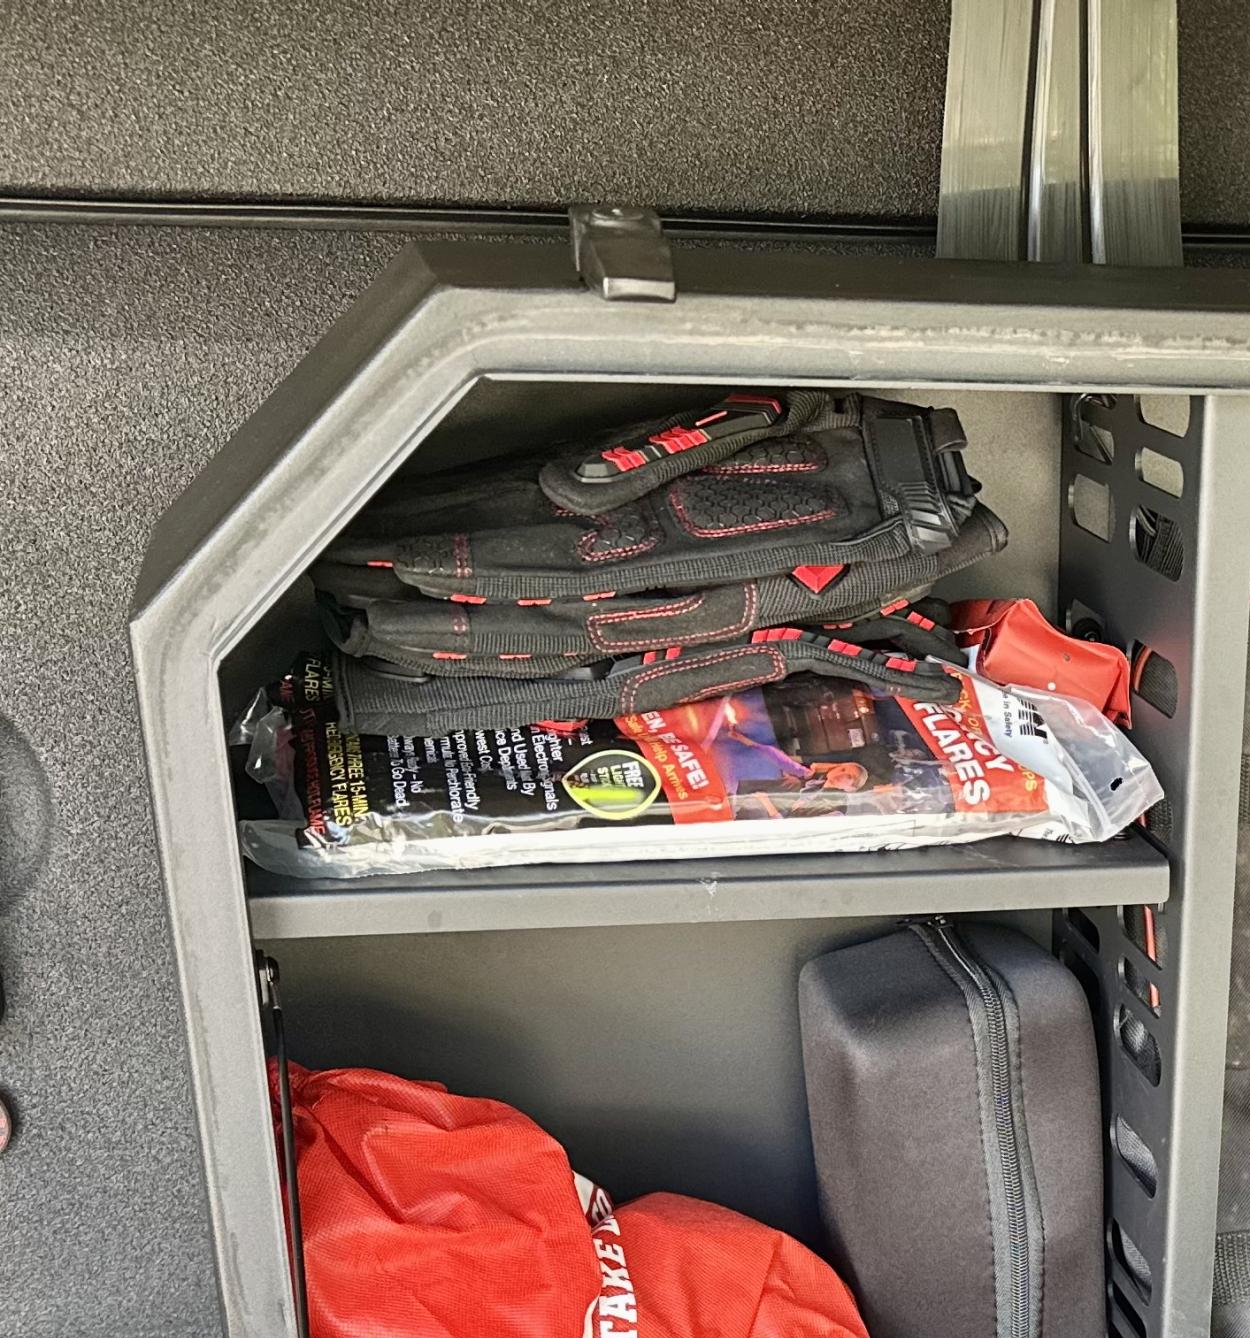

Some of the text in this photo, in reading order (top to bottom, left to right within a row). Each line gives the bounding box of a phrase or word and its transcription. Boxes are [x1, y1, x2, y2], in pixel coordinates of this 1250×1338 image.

[304, 657, 321, 702] FLARES
[1003, 711, 1013, 739] Safety
[513, 743, 532, 770] Used
[670, 743, 710, 791] SAFE!
[912, 700, 991, 806] FLARES
[391, 767, 405, 780] Go
[410, 781, 424, 794] No
[621, 760, 645, 788] FREE
[393, 781, 410, 808] Dead
[445, 768, 465, 824] Perchlorate
[520, 782, 537, 796] By
[331, 782, 353, 828] FLARES
